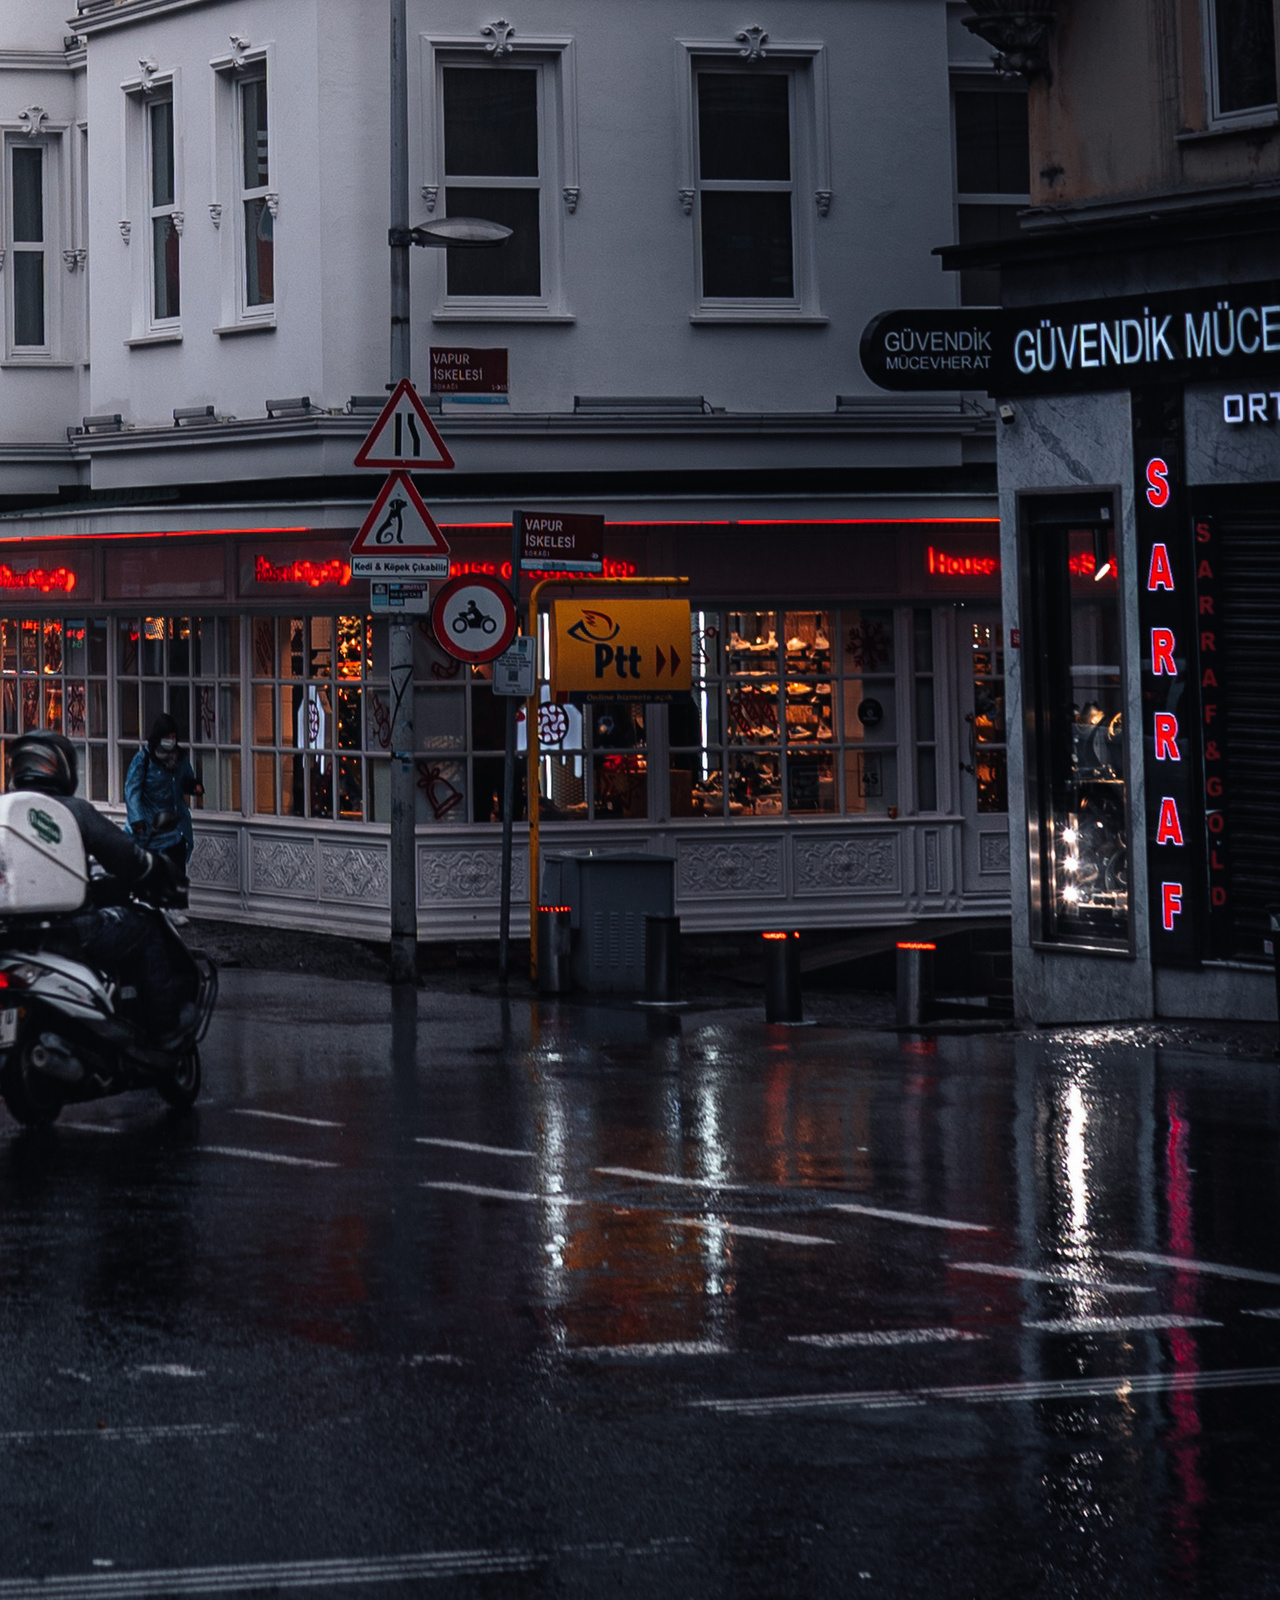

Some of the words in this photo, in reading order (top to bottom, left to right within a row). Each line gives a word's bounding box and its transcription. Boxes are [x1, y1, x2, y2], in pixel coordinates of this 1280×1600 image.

[884, 327, 992, 352] GÜVENDİK
[1014, 306, 1175, 374] GÜVENDİK
[1185, 301, 1280, 358] MÜCE
[432, 353, 470, 365] VAPUR
[886, 354, 991, 370] MÜCEVHERAT
[433, 367, 483, 381] İSKELESİ
[525, 519, 563, 531] VAPUR
[525, 533, 575, 548] İSKELESİ
[354, 562, 373, 571] Kedi
[375, 563, 382, 571] &
[384, 562, 410, 573] Köpek
[412, 563, 448, 573] Çıkabilir
[595, 643, 642, 679] Ptt
[1146, 458, 1184, 930] SARRAF
